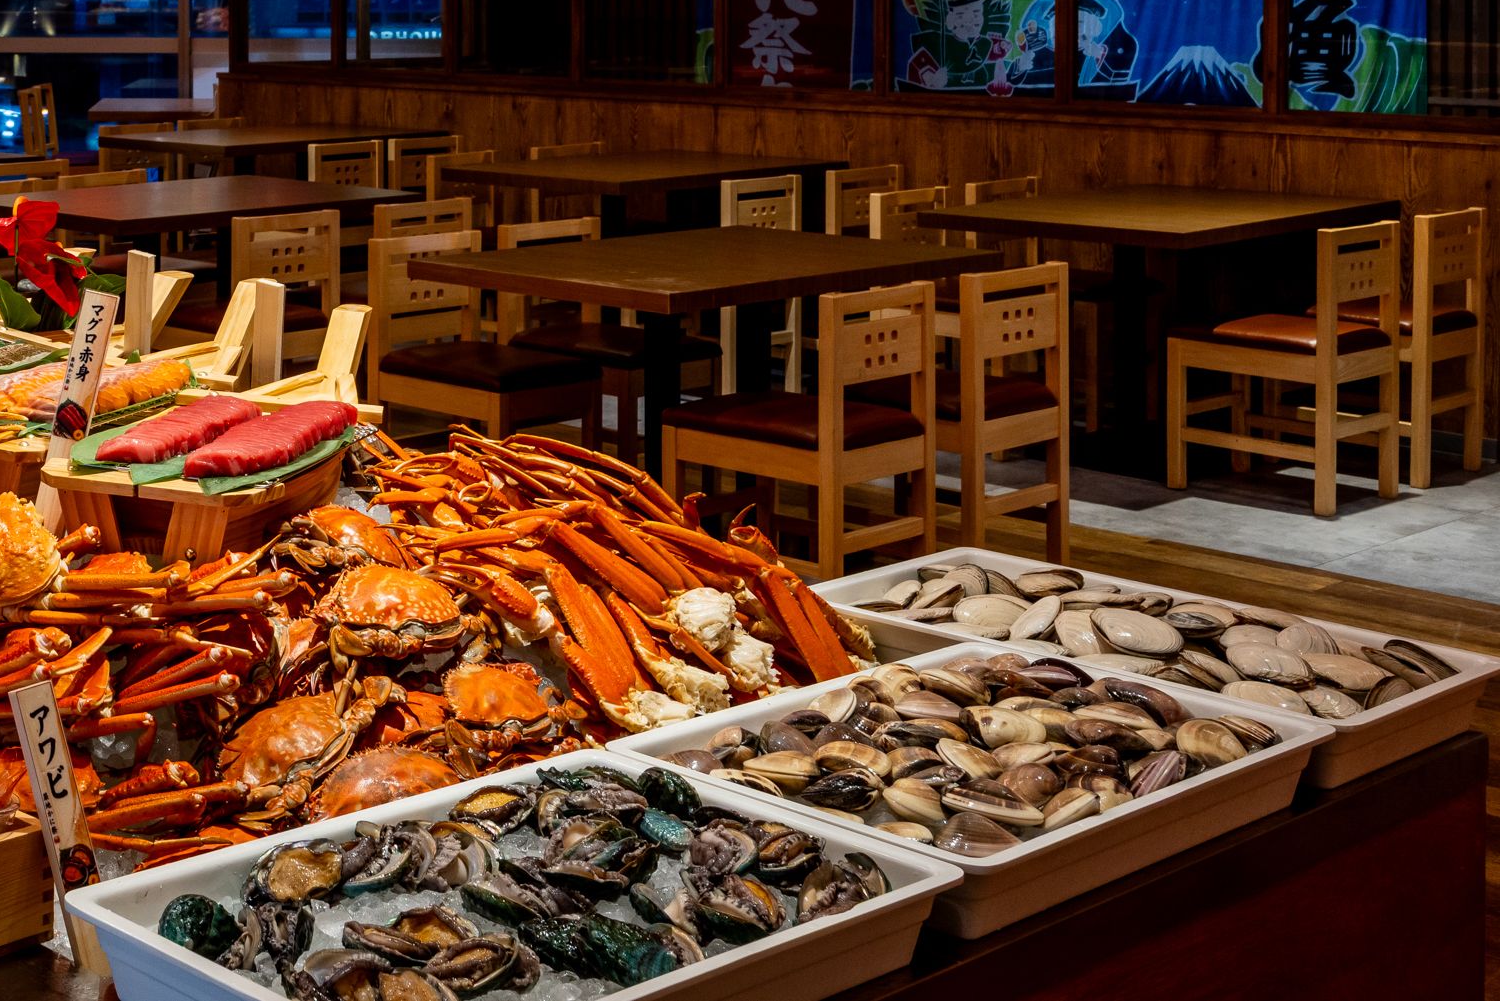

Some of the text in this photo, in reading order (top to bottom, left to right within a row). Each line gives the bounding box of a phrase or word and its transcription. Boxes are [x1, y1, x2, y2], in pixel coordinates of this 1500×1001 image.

[75, 304, 105, 383] マグロ赤身
[29, 705, 69, 799] アワビ
